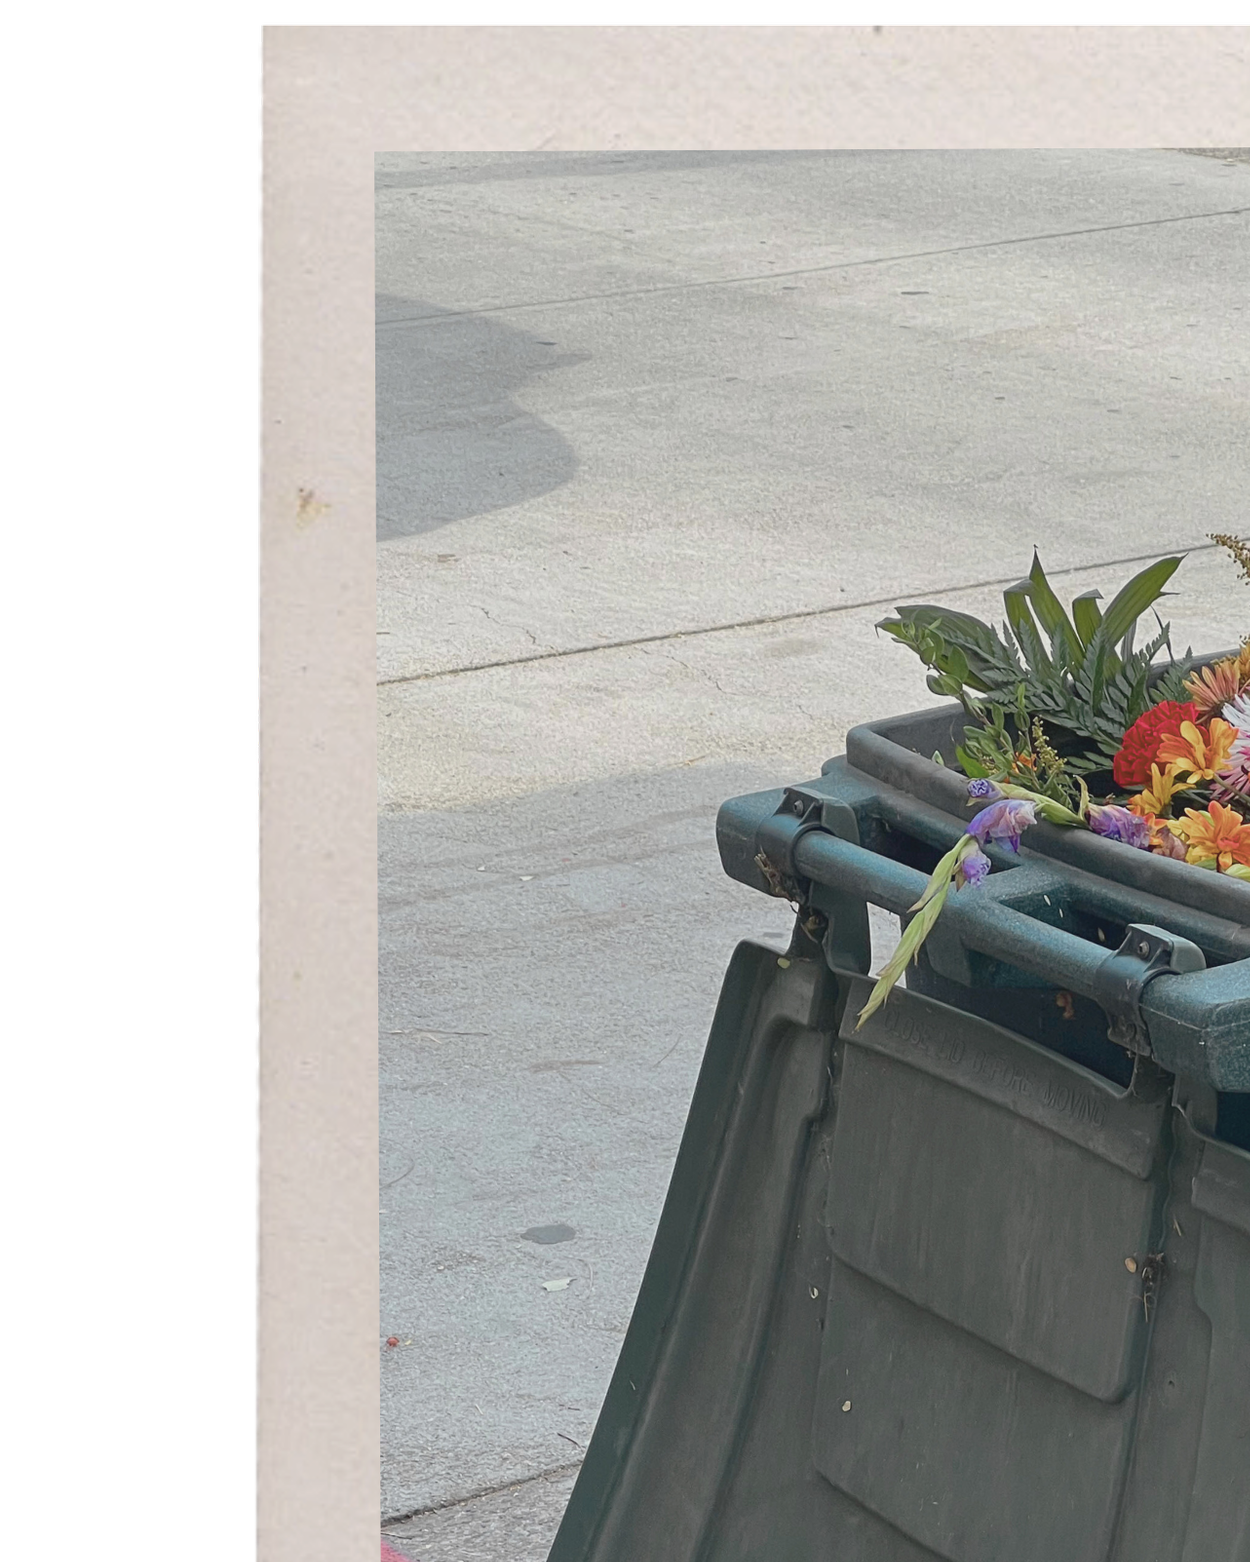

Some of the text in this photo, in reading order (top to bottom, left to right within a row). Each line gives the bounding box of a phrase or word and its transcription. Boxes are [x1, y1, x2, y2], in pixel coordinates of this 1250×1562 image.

[883, 1009, 1109, 1127] CLOSE LID BEFORE MOVING
